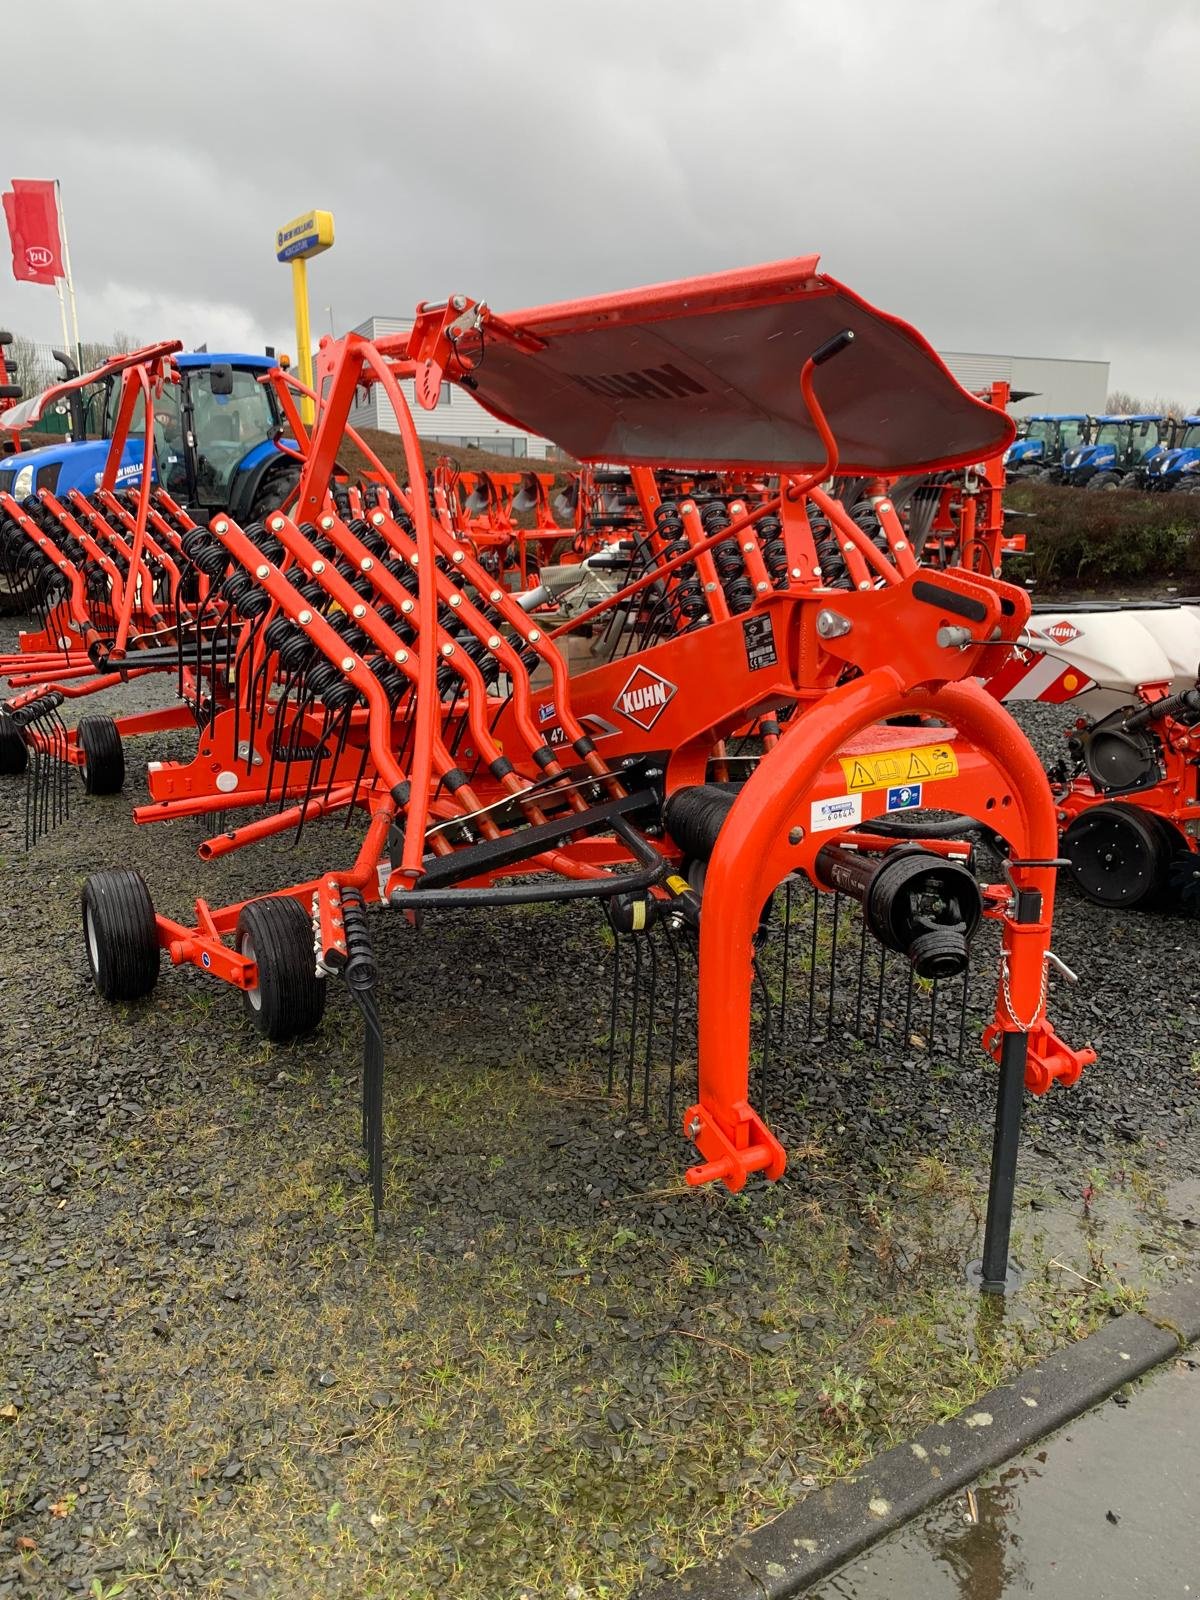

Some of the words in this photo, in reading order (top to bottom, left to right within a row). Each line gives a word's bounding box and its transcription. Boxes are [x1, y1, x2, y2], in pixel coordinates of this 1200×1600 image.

[293, 219, 313, 237] HOLLAND
[124, 463, 144, 475] HOLLA
[1049, 626, 1078, 637] KUHN
[623, 682, 667, 714] KUHN
[551, 727, 568, 743] 47
